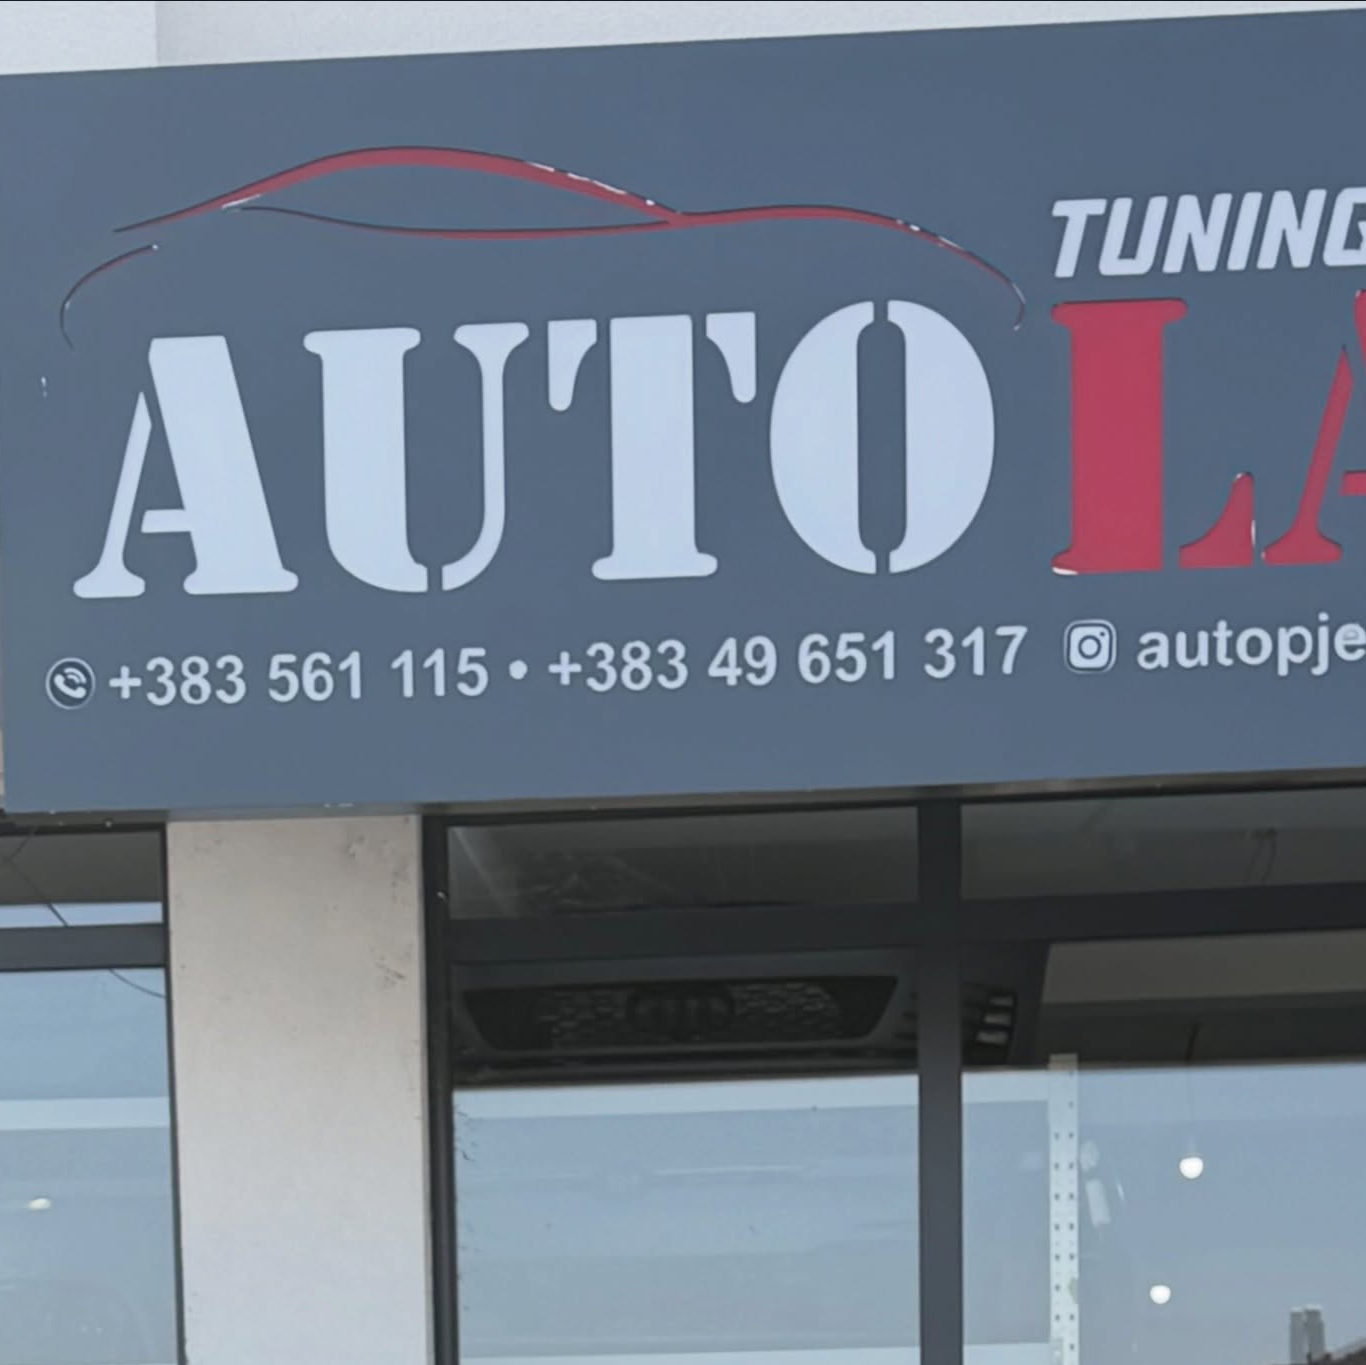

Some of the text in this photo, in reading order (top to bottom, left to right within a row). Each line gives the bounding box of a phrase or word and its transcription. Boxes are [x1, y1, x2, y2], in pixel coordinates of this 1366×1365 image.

[73, 299, 995, 598] AUTO
[109, 655, 246, 706] +383
[267, 651, 363, 700] 561
[389, 646, 489, 697] 115
[547, 639, 689, 690] +383
[708, 635, 776, 686] 49
[797, 631, 897, 682] 651
[924, 625, 1028, 677] 317
